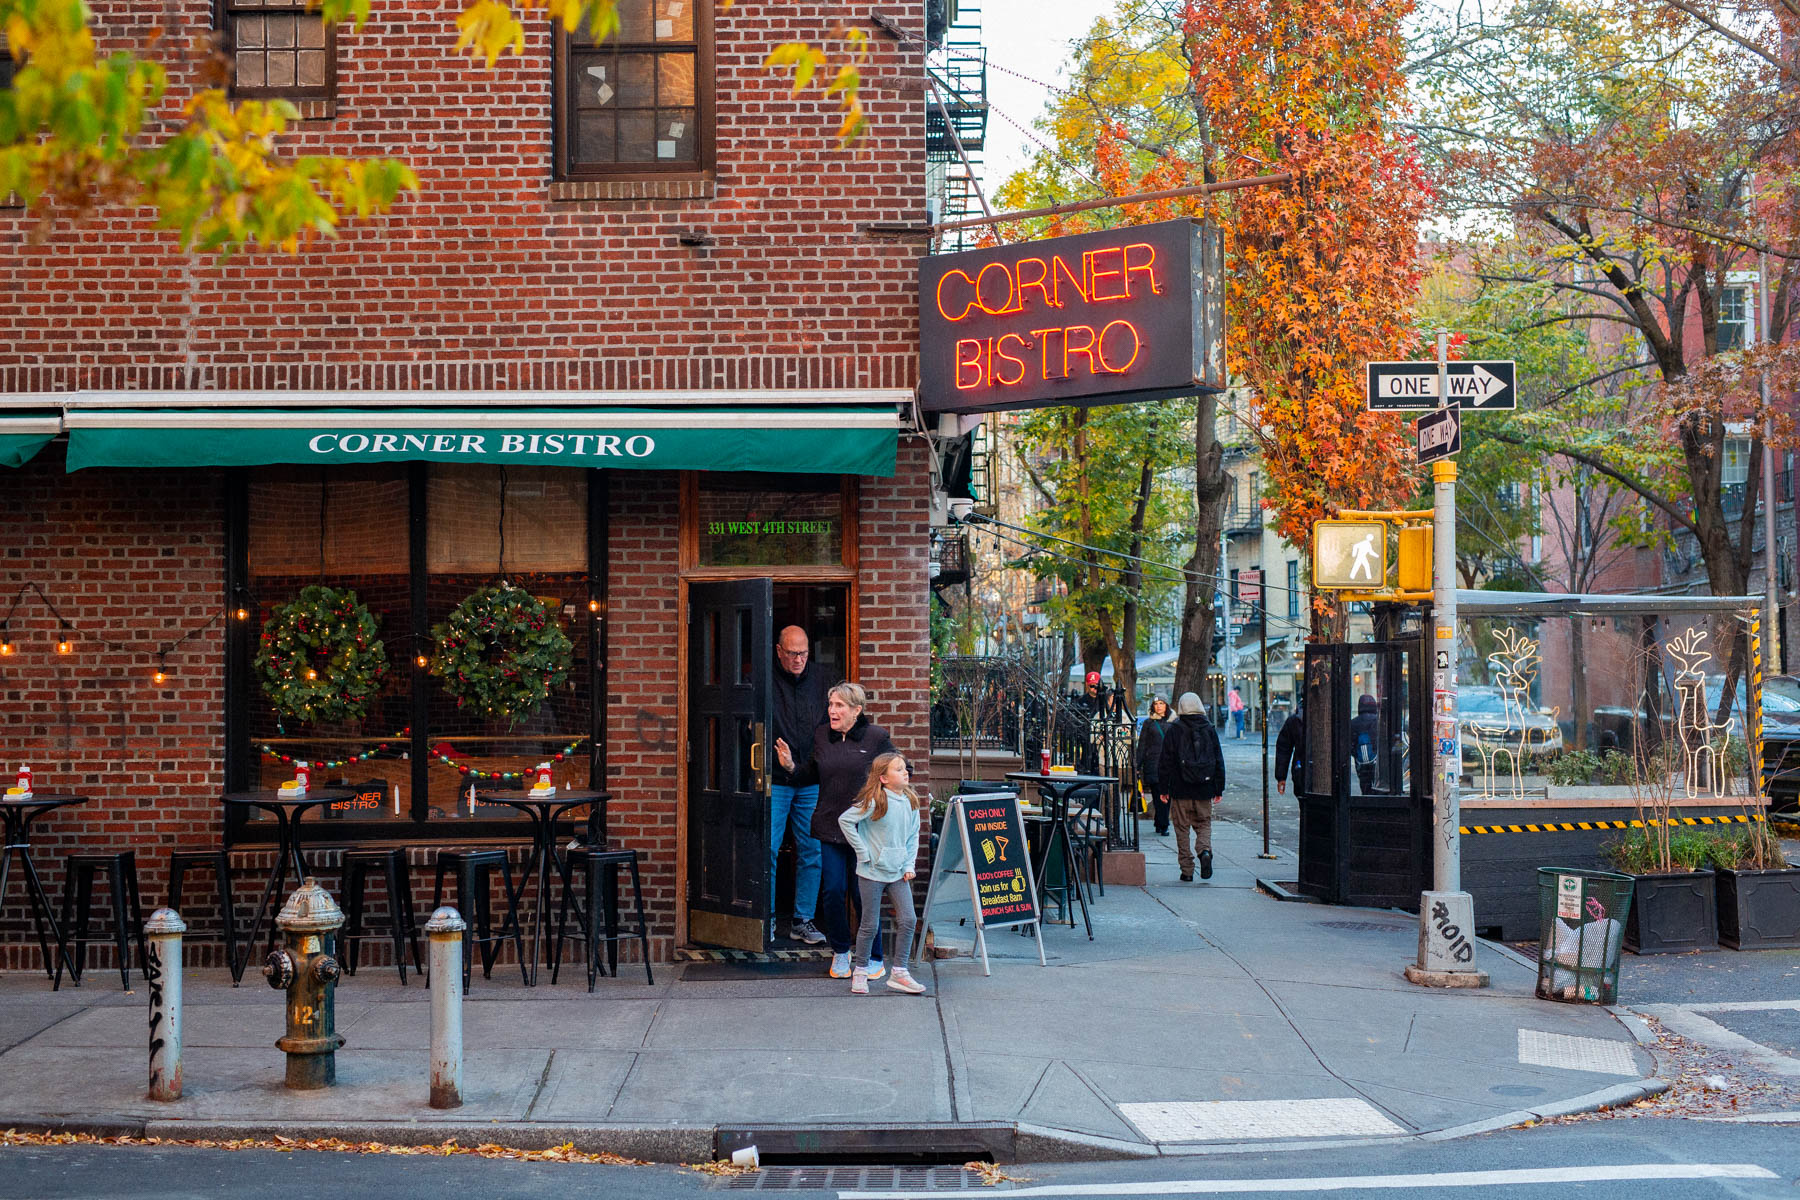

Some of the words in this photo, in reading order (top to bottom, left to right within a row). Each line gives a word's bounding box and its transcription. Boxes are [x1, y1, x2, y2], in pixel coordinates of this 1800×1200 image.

[936, 243, 1163, 322] CORNER
[955, 319, 1140, 390] BISTRO
[1390, 377, 1431, 395] ONE
[1450, 377, 1492, 395] WAY
[1422, 428, 1435, 448] ONE
[1439, 421, 1453, 443] WAY
[308, 433, 487, 454] CORNER
[497, 433, 656, 458] BISTRO
[707, 521, 725, 535] 331
[728, 521, 760, 535] WEST
[762, 521, 785, 534] 4TH
[787, 521, 832, 534] STREET
[330, 800, 379, 810] BISTRO
[969, 808, 987, 819] CASH
[988, 807, 1006, 818] ONLY
[974, 822, 987, 832] ATM
[987, 821, 1008, 831] INSIDE
[994, 869, 1015, 879] COFFEE
[979, 883, 992, 893] Join
[1000, 881, 1009, 891] for
[981, 894, 1009, 906] Breakfast
[1009, 893, 1023, 902] 8am
[981, 907, 1004, 917] BRUNCH
